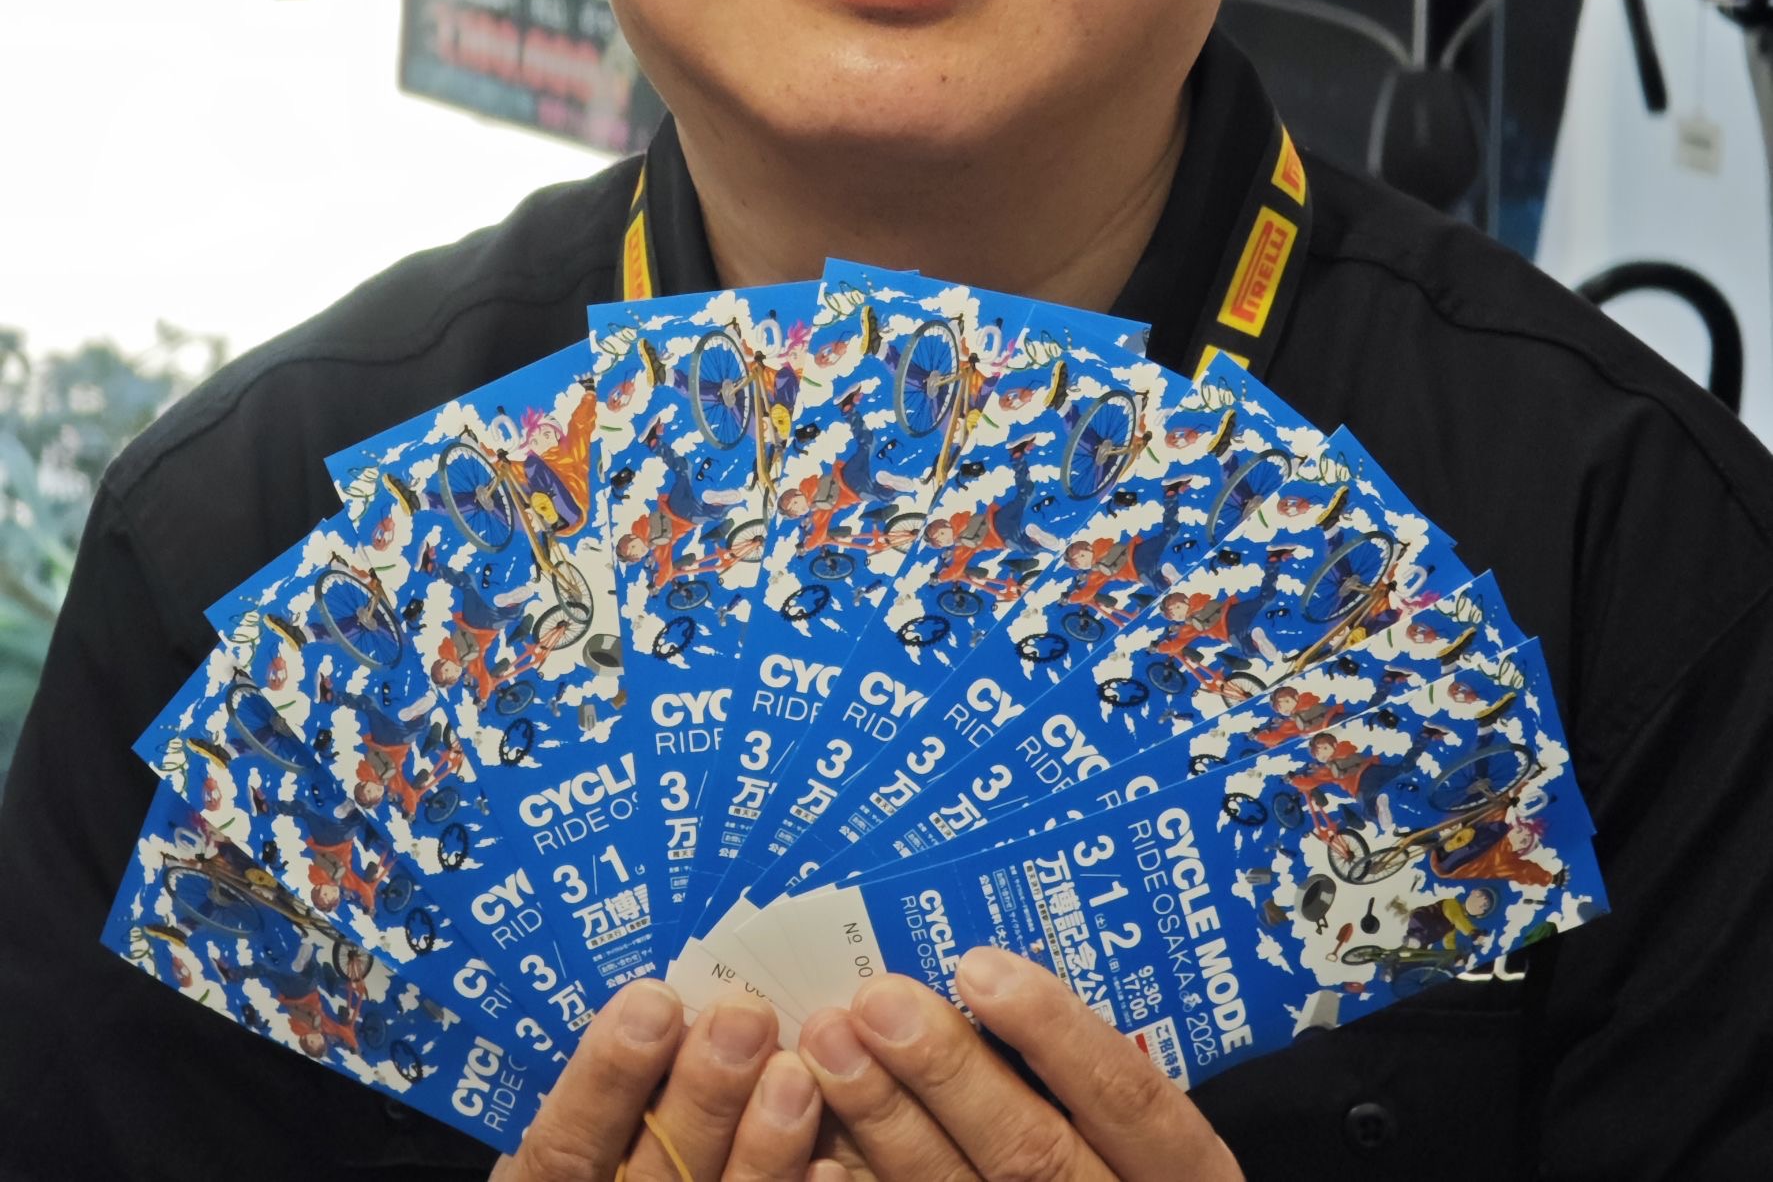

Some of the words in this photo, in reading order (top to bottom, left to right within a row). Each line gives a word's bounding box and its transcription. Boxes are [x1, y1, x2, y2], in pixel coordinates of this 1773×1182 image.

[1230, 220, 1289, 325] PIRELLI
[919, 889, 961, 976] CYCLE
[1156, 807, 1221, 939] CYCLE
[1194, 937, 1254, 1056] MODE
[917, 943, 945, 993] OSAK
[1122, 972, 1149, 1020] 17:00
[1186, 1012, 1219, 1067] 2025
